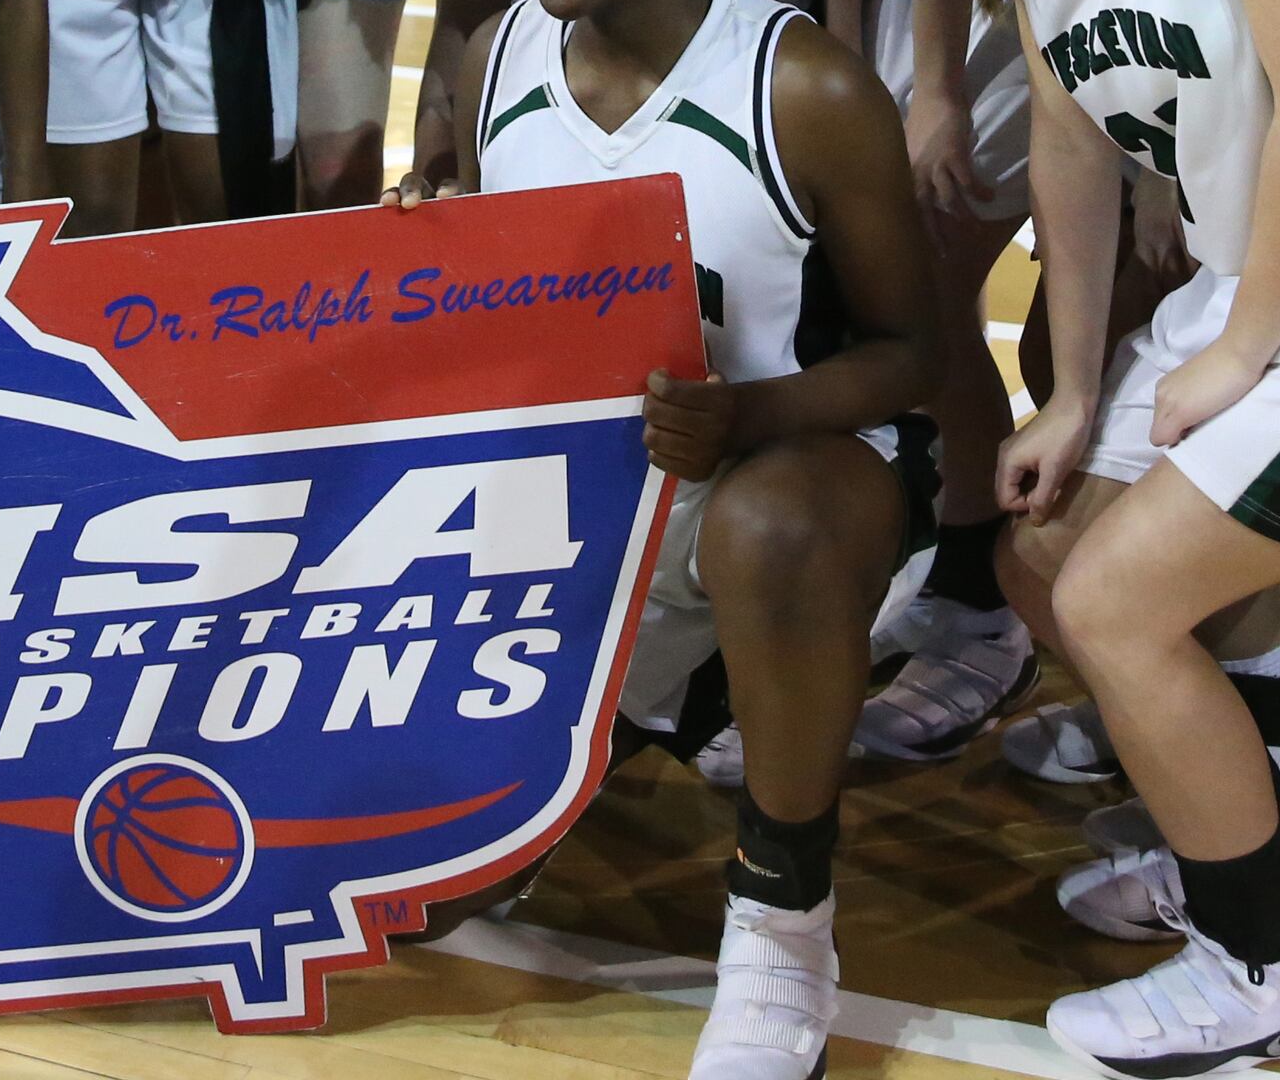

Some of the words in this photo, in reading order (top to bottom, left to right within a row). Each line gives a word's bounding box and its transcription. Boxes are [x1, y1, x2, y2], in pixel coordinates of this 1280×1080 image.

[1042, 8, 1212, 94] ESLEYAN
[105, 296, 197, 350] Dr.
[210, 270, 375, 344] Ralph
[391, 259, 676, 322] Swearngin
[366, 900, 408, 926] TM
